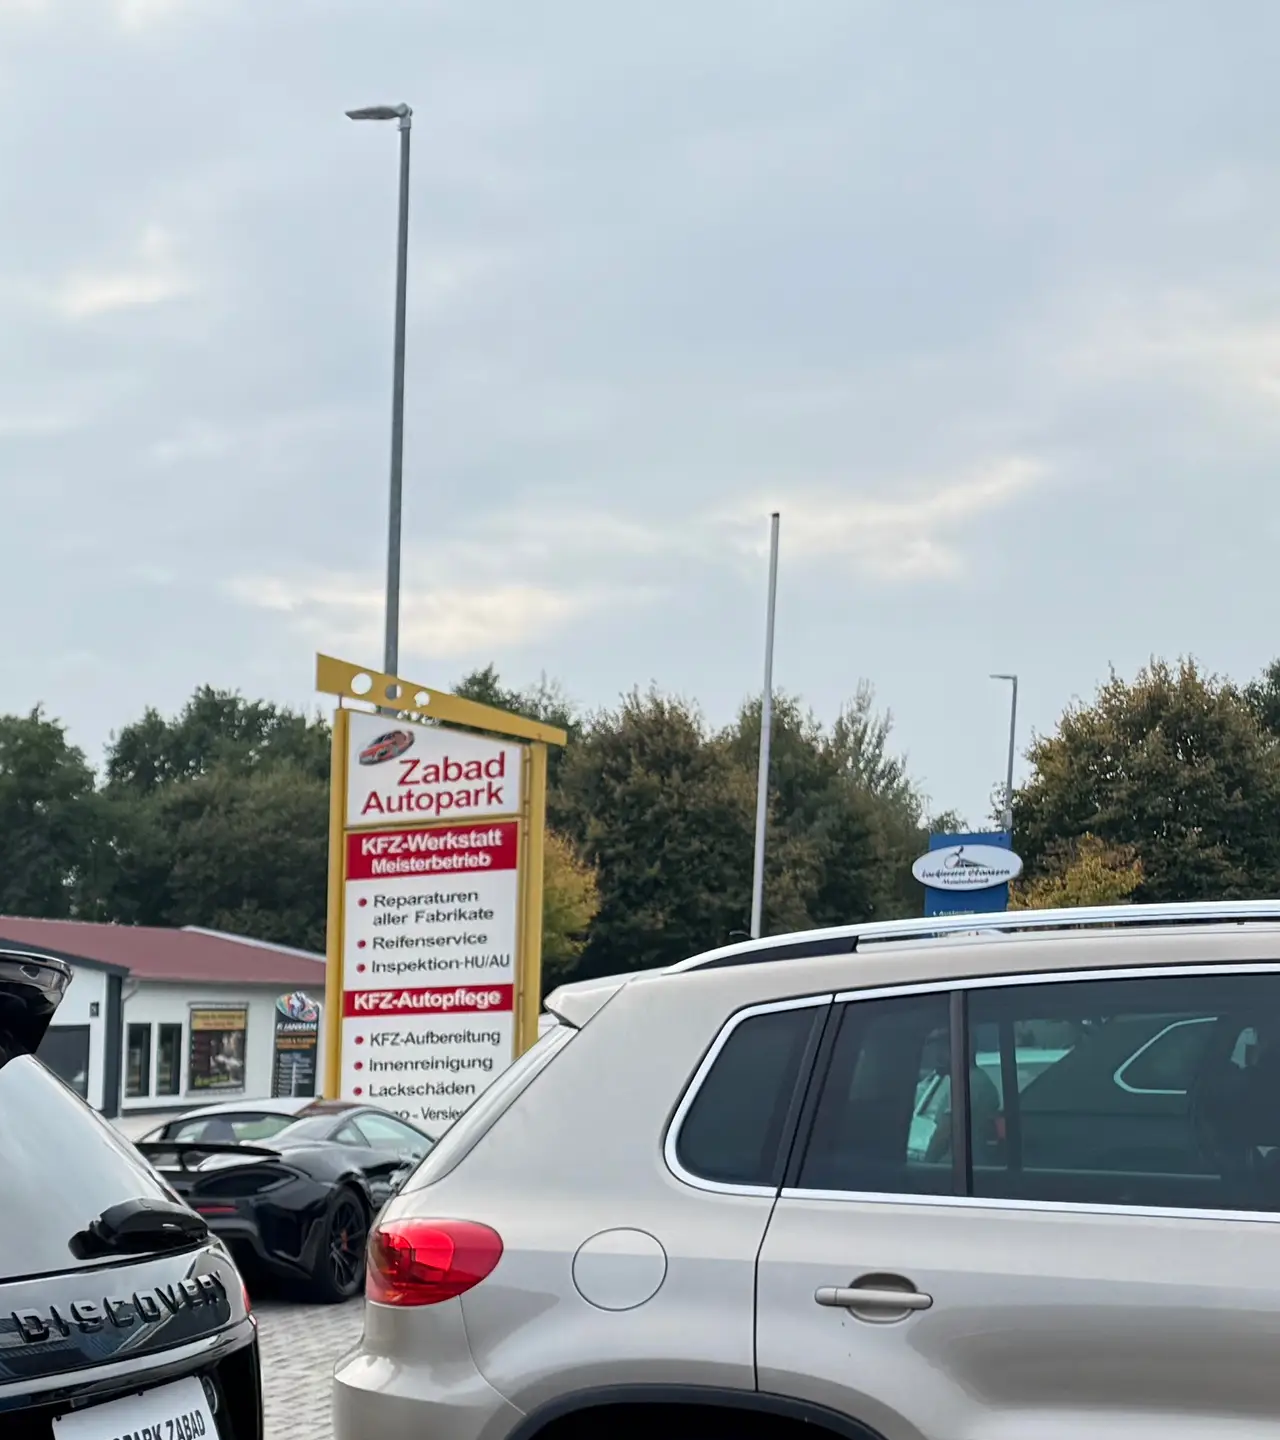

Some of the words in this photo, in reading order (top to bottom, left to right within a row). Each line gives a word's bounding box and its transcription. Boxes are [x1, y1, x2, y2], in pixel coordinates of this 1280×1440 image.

[397, 751, 506, 787] Zabad
[361, 782, 504, 816] Autopark
[361, 829, 503, 856] KFZ-Werkstatt
[371, 851, 492, 875] Meisterbetrieb
[373, 890, 479, 910] Reparaturen
[372, 913, 409, 927] aller
[414, 907, 495, 925] Fabrikate
[372, 932, 488, 950] Reifenservice
[371, 953, 511, 975] Inspektion-HU/AU
[354, 988, 502, 1011] KFZ-Autopflege
[370, 1029, 501, 1048] KFZ-Aufbereitung
[369, 1056, 494, 1074] Innenreinigung
[369, 1081, 476, 1098] Lackschäden
[420, 1104, 465, 1121] Versie
[11, 1270, 227, 1343] DISCOVERY
